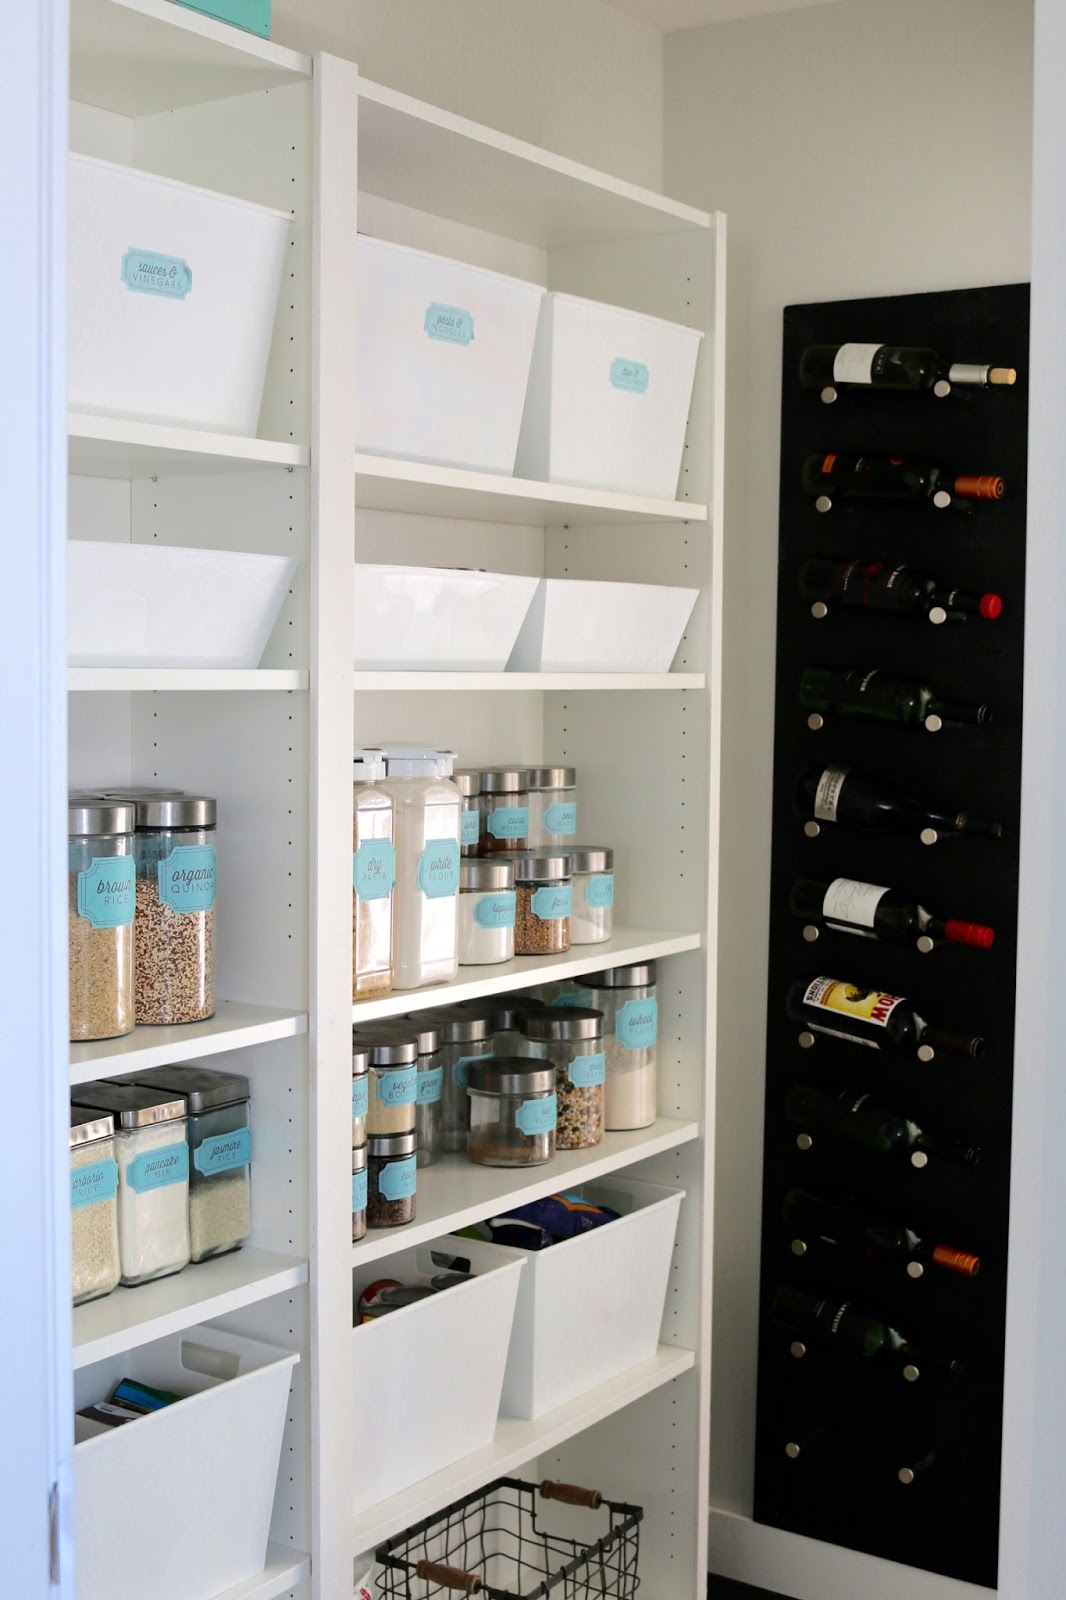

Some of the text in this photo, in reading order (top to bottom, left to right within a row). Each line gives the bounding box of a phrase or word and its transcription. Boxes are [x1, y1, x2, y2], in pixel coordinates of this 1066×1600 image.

[138, 262, 178, 279] sauces &
[133, 272, 182, 291] VINEGARS
[501, 824, 528, 832] POWDE
[367, 857, 382, 875] dry
[430, 856, 453, 871] white
[171, 865, 214, 886] organic
[363, 872, 387, 881] PASTA
[429, 871, 454, 881] FLOUR
[96, 879, 131, 895] brown
[104, 895, 129, 906] RICE
[209, 1139, 242, 1161] jasmine
[217, 1152, 237, 1163] RICE
[144, 1155, 181, 1176] pancake
[72, 1170, 104, 1189] arborio
[154, 1169, 172, 1179] MIX
[78, 1184, 100, 1197] RICE
